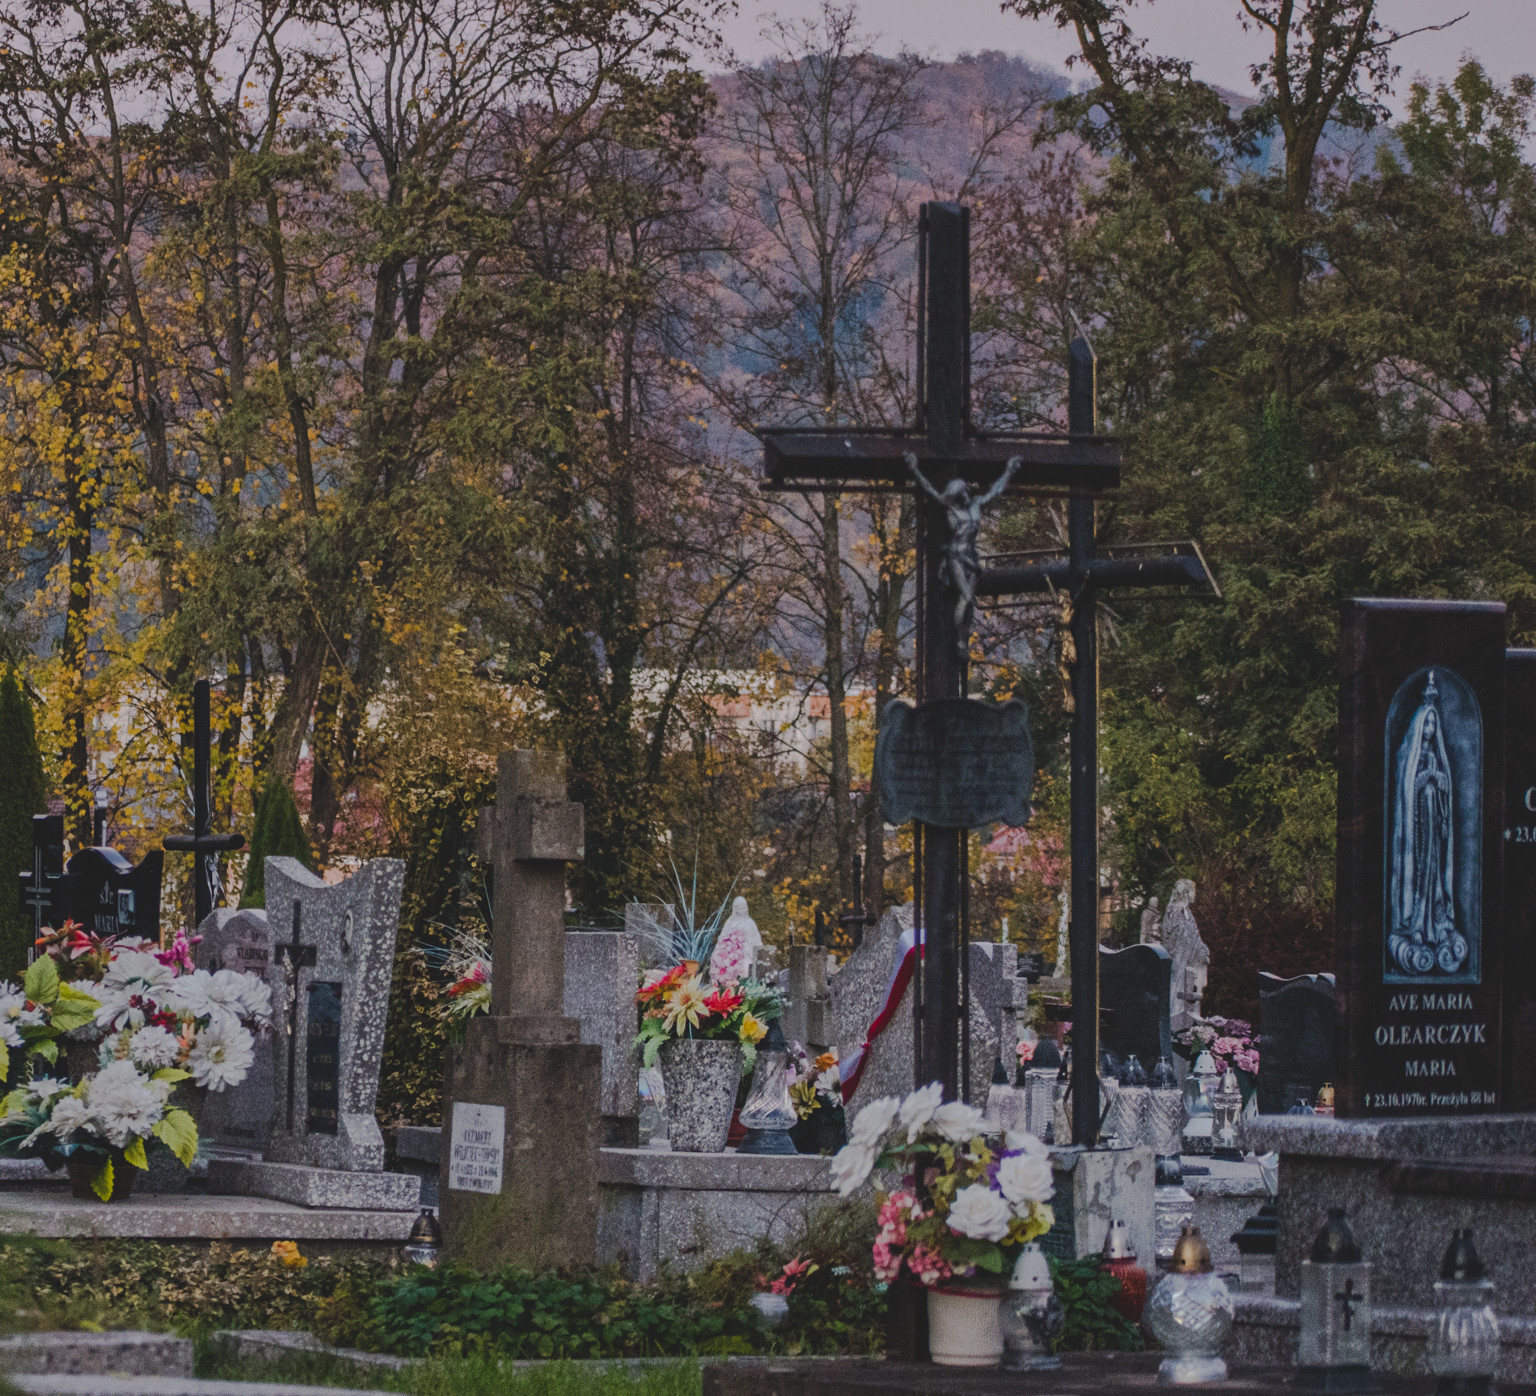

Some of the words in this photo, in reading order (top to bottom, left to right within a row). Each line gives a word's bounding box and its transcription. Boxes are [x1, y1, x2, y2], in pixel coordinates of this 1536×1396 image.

[1389, 994, 1419, 1011] AVE
[1422, 992, 1474, 1010] MARIA
[1374, 1023, 1486, 1046] OLEARCZYK
[1405, 1059, 1457, 1078] MARIA
[1470, 1091, 1482, 1104] 88
[1484, 1091, 1496, 1104] lat
